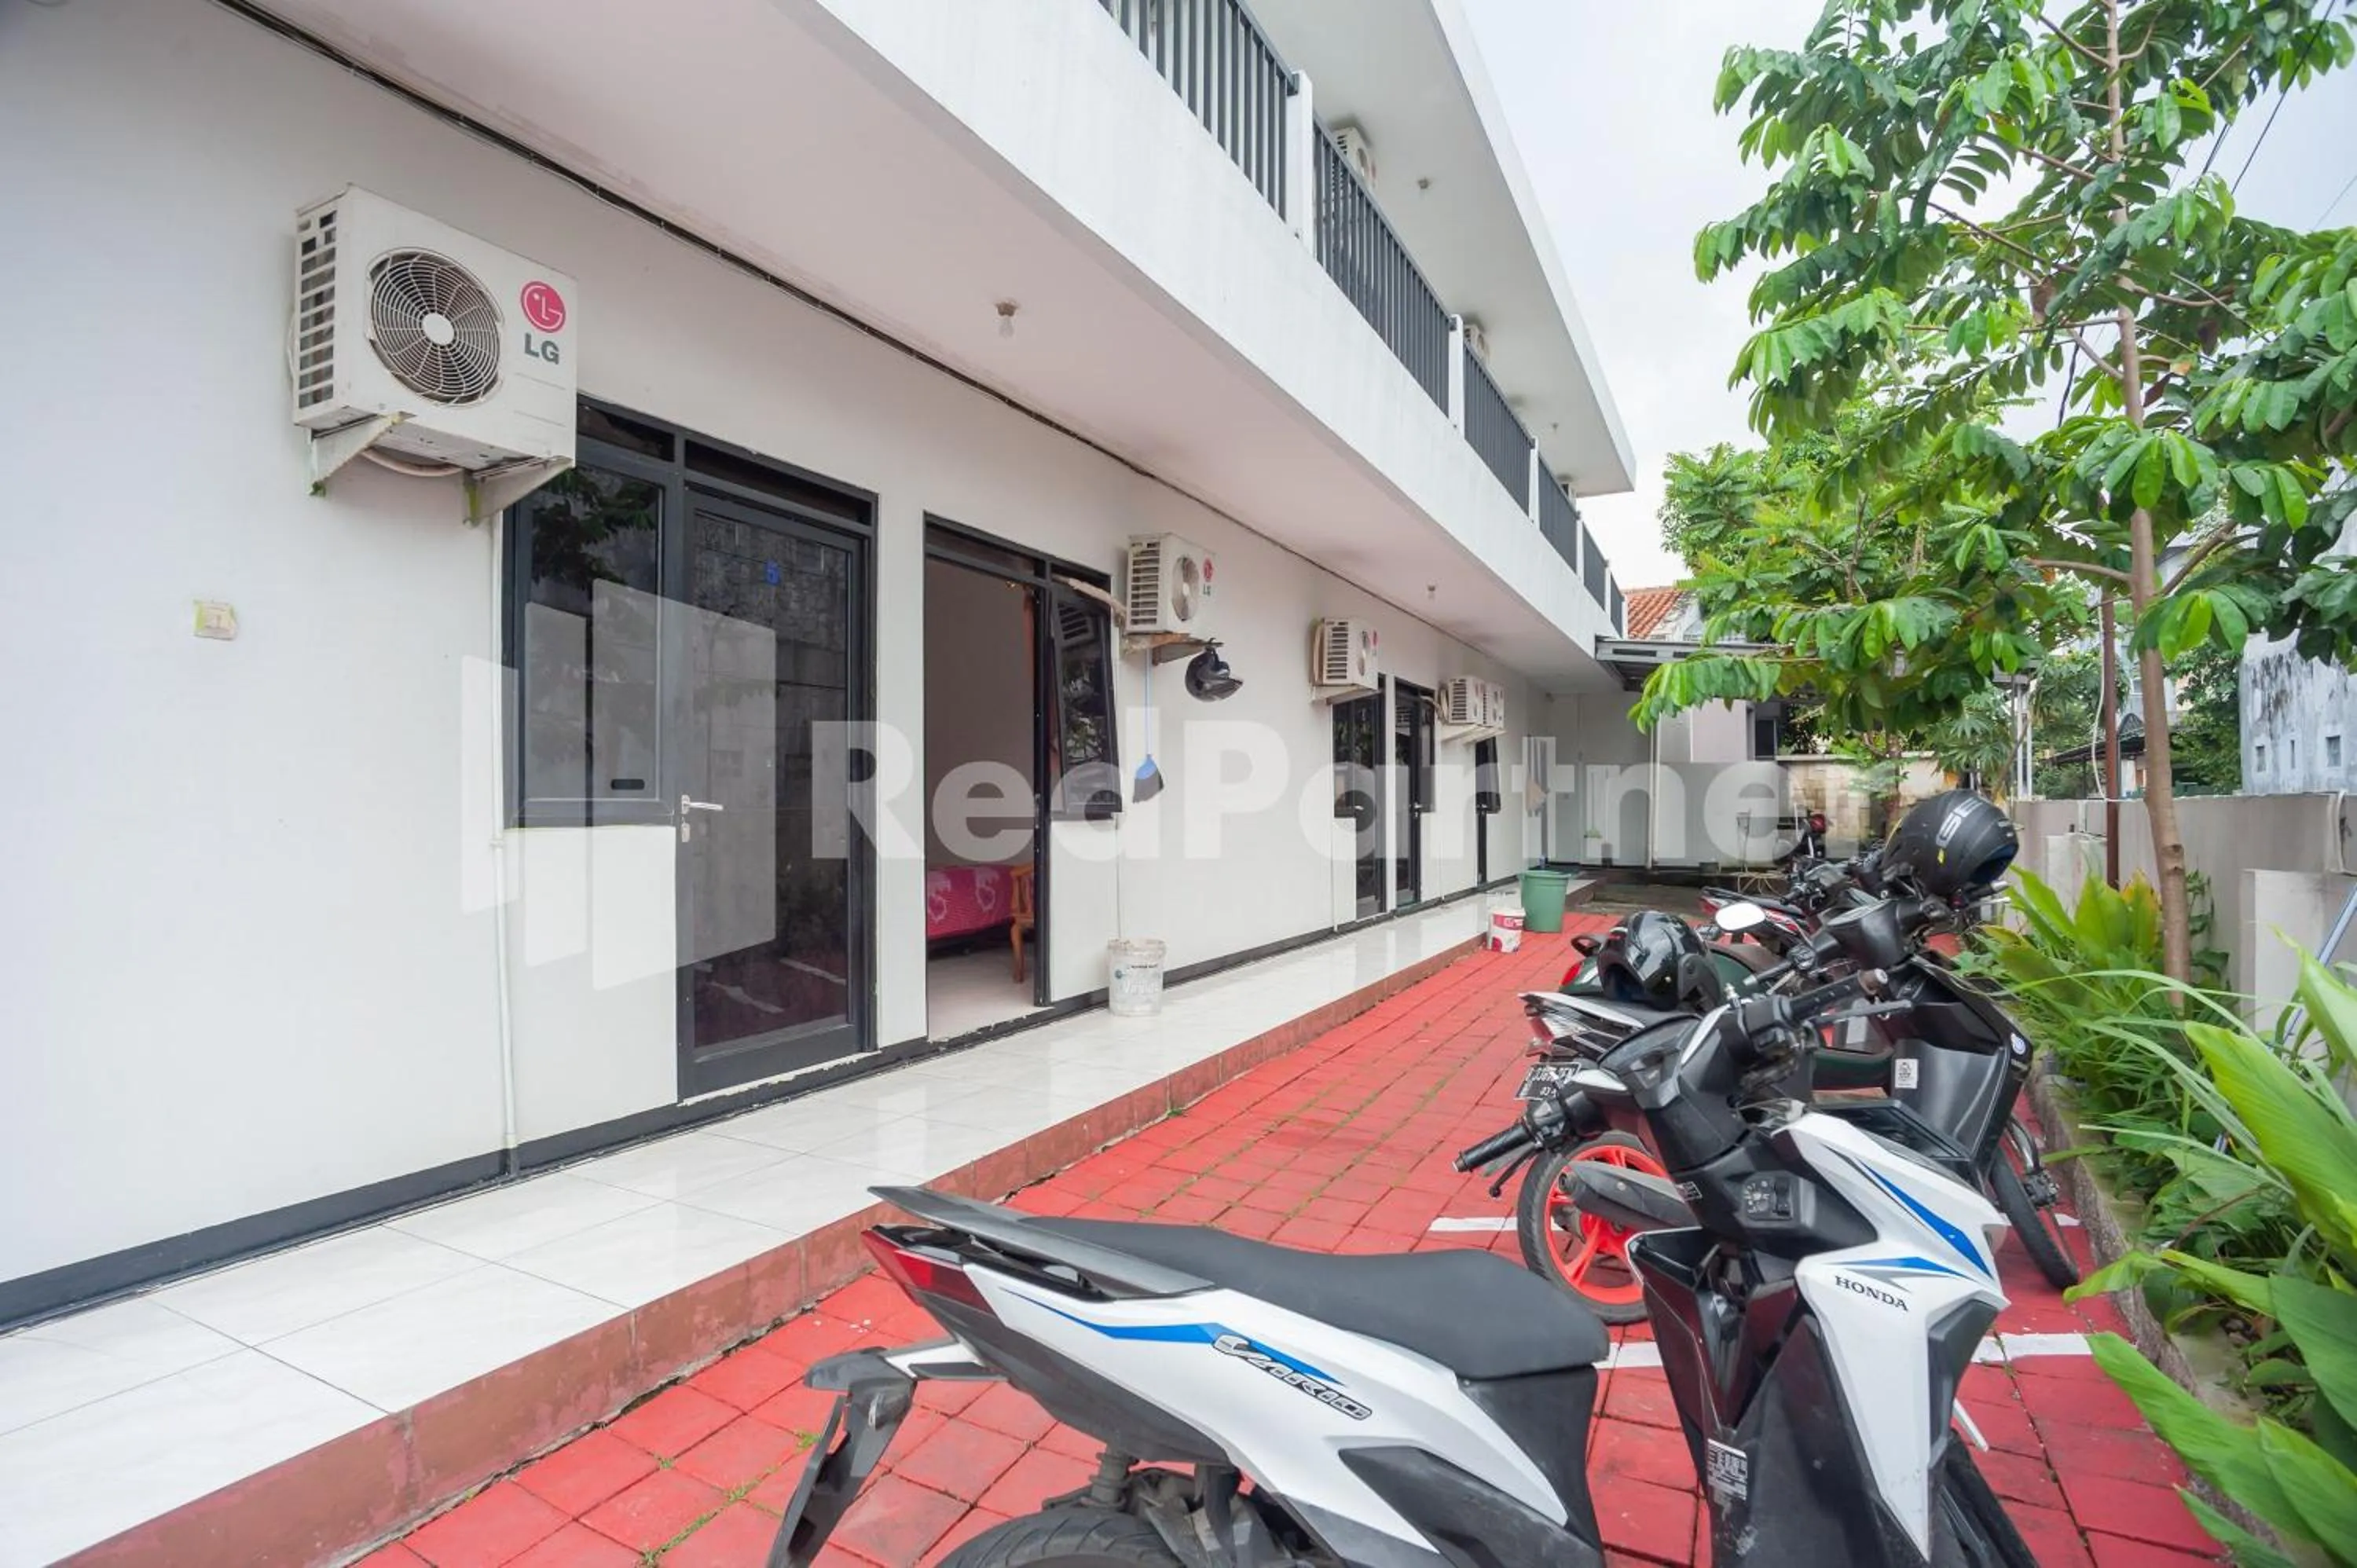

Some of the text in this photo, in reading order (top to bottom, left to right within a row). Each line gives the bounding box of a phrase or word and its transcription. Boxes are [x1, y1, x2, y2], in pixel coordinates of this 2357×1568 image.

[524, 332, 559, 365] LG
[1835, 1275, 1908, 1312] HONDA
[1212, 1334, 1373, 1420] VARIO
